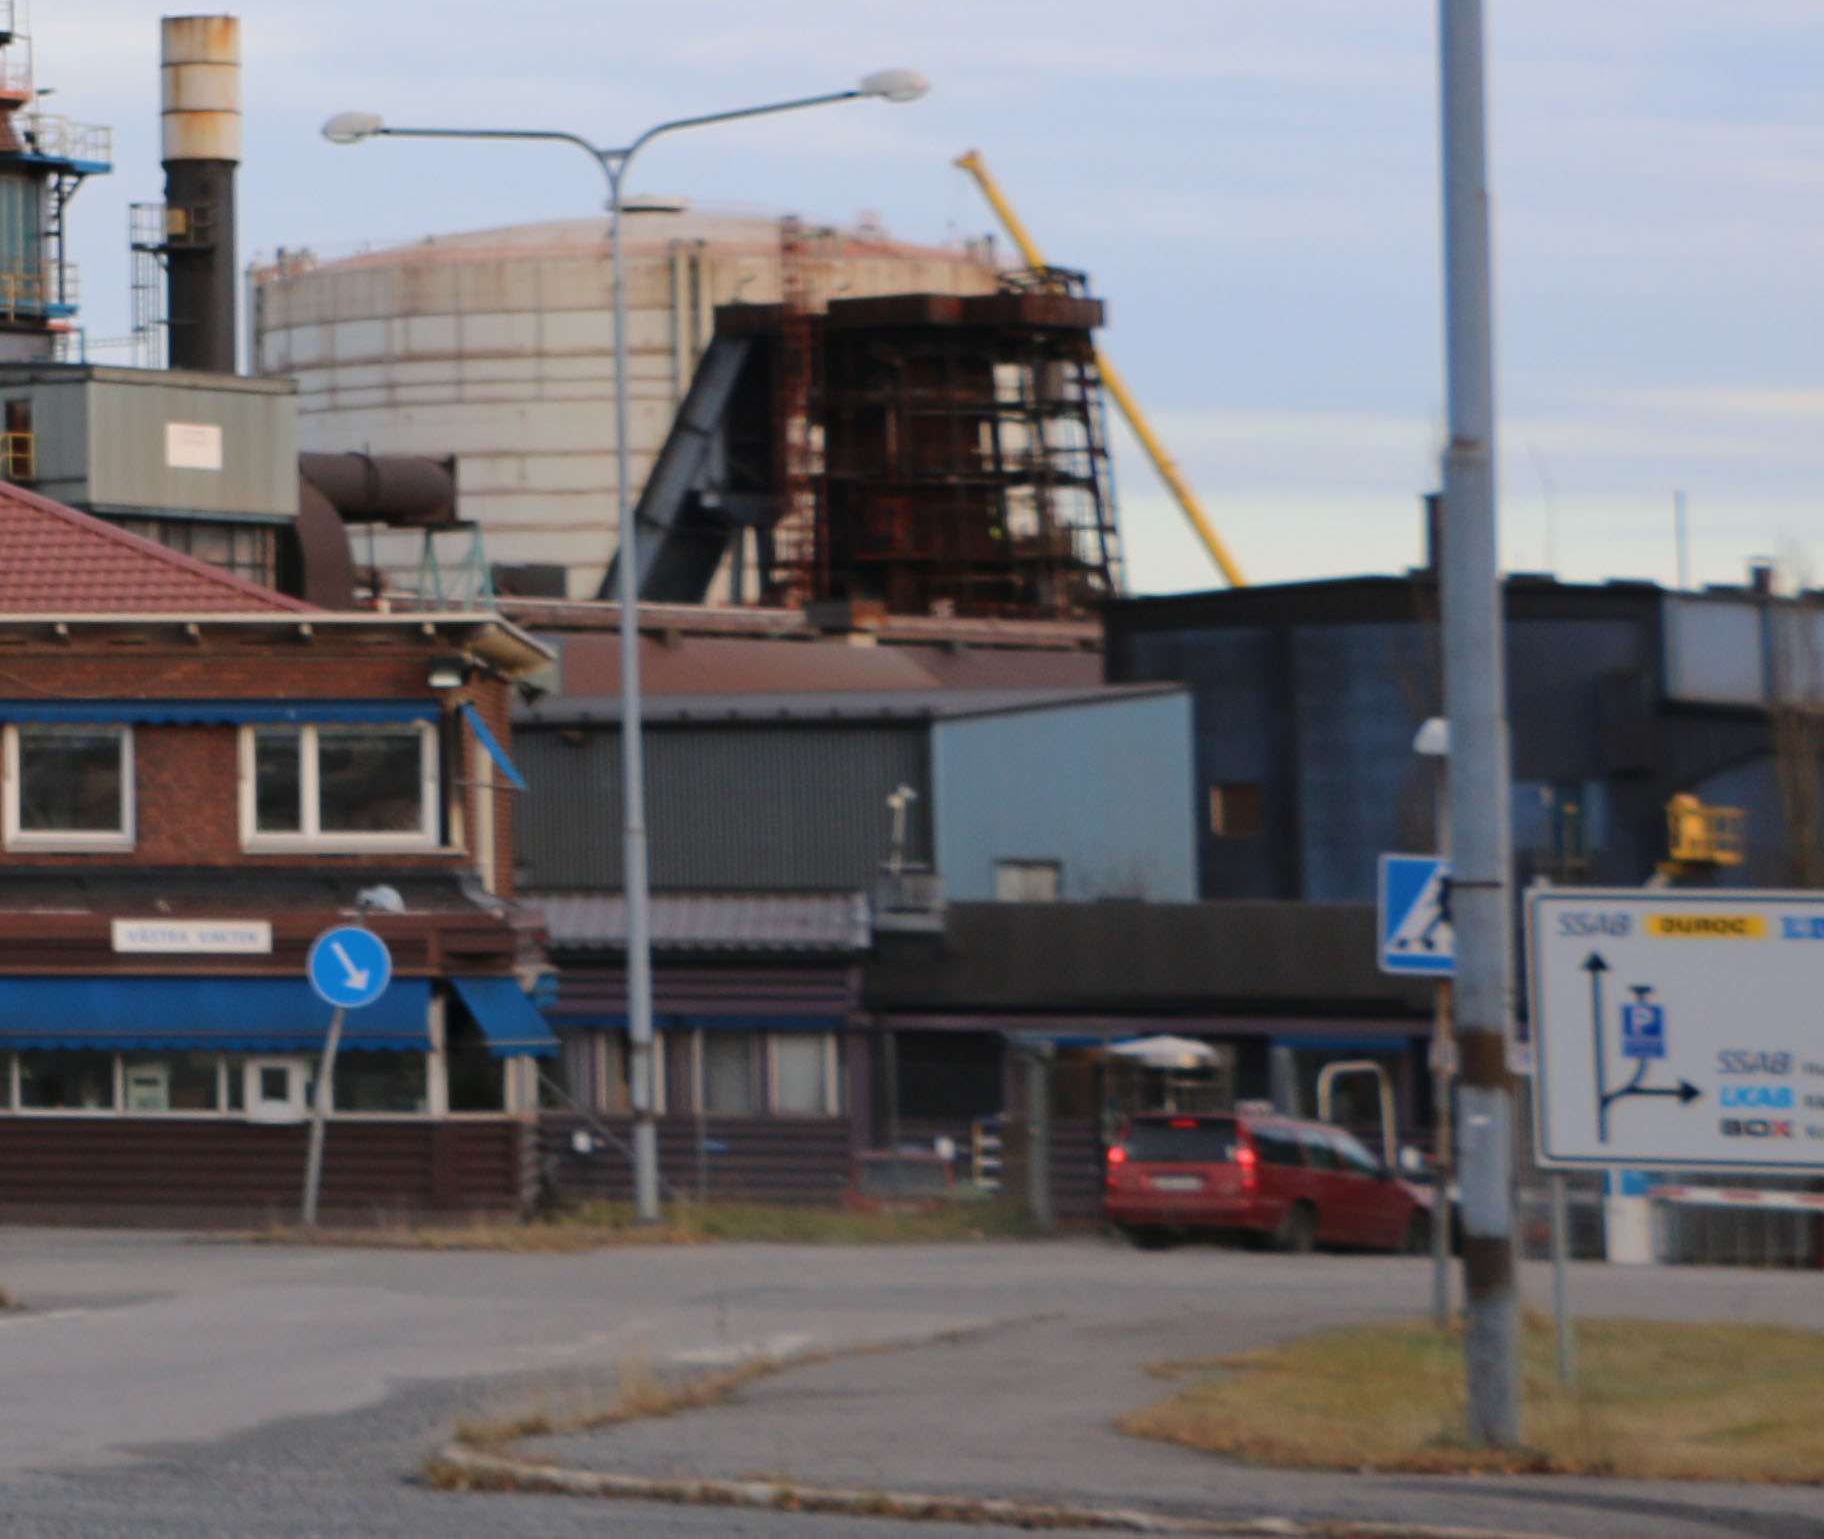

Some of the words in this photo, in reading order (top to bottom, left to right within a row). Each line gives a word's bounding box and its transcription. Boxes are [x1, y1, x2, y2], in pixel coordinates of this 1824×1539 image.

[1557, 912, 1632, 936] SSAB
[1659, 917, 1747, 934] DUROC
[1718, 1050, 1794, 1075] SSAB
[1720, 1118, 1794, 1138] BOX
